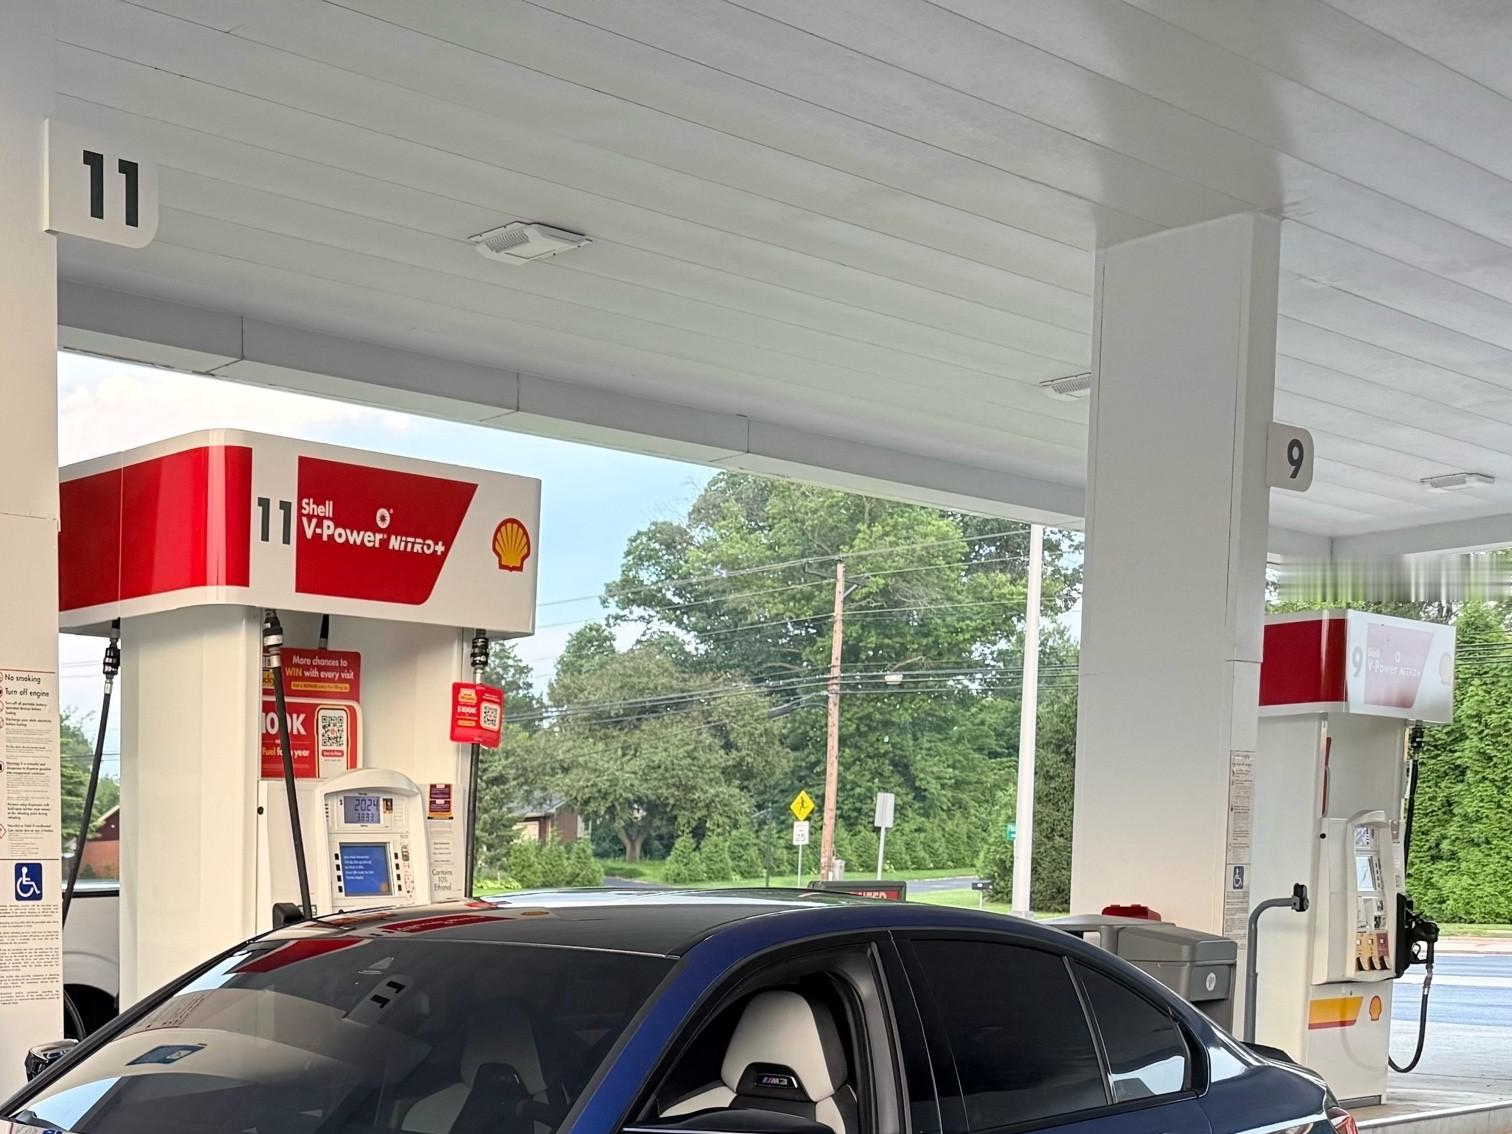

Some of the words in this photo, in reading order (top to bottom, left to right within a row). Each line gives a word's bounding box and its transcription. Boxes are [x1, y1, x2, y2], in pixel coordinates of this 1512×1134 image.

[83, 149, 138, 228] 11
[1287, 438, 1304, 479] 9
[301, 498, 333, 517] Shell
[257, 497, 292, 545] 11
[301, 517, 385, 548] V-Power
[292, 655, 311, 665] More
[312, 656, 339, 667] chances
[340, 658, 348, 667] to
[1352, 646, 1363, 678] 9
[5, 673, 14, 681] No
[16, 675, 41, 684] smoking
[285, 667, 303, 677] WIN
[303, 668, 319, 678] with
[320, 670, 339, 680] every
[341, 670, 354, 679] visit
[5, 687, 17, 695] Turn
[19, 688, 28, 696] off
[294, 750, 310, 758] year
